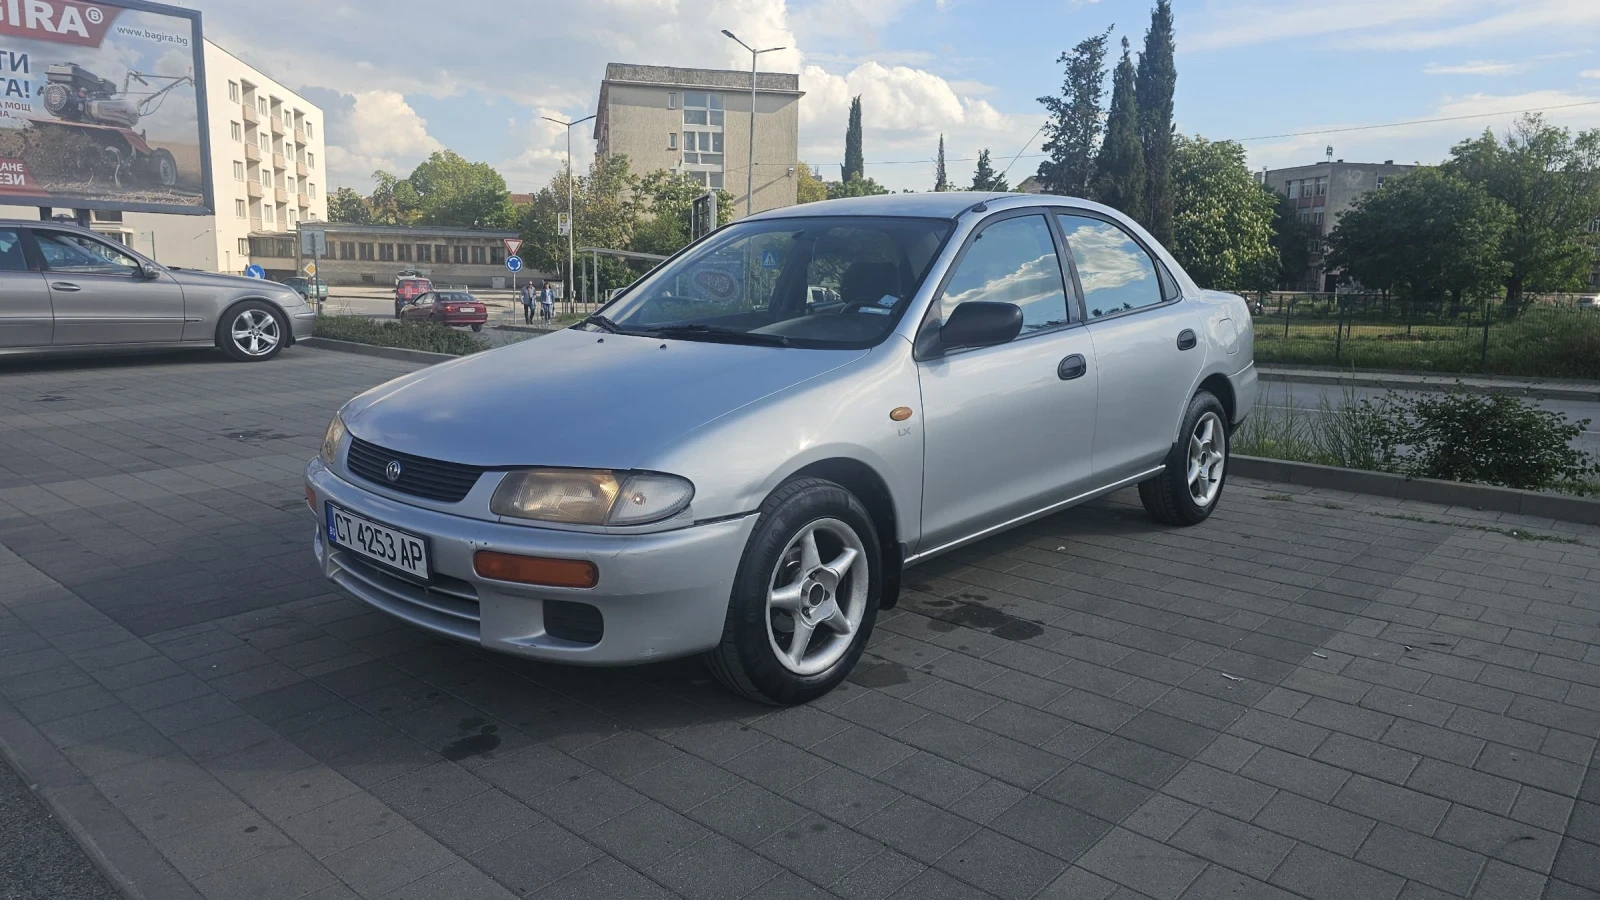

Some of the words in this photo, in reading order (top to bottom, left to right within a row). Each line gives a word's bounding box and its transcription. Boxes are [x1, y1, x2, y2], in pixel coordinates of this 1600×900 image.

[0, 0, 89, 38] IRA
[117, 27, 188, 46] www.bagira.bg
[5, 101, 31, 113] МОЩ
[0, 162, 24, 172] АНЕ
[898, 427, 911, 437] LX
[335, 512, 352, 545] CT
[357, 522, 397, 562] 4253
[401, 537, 422, 571] AP
